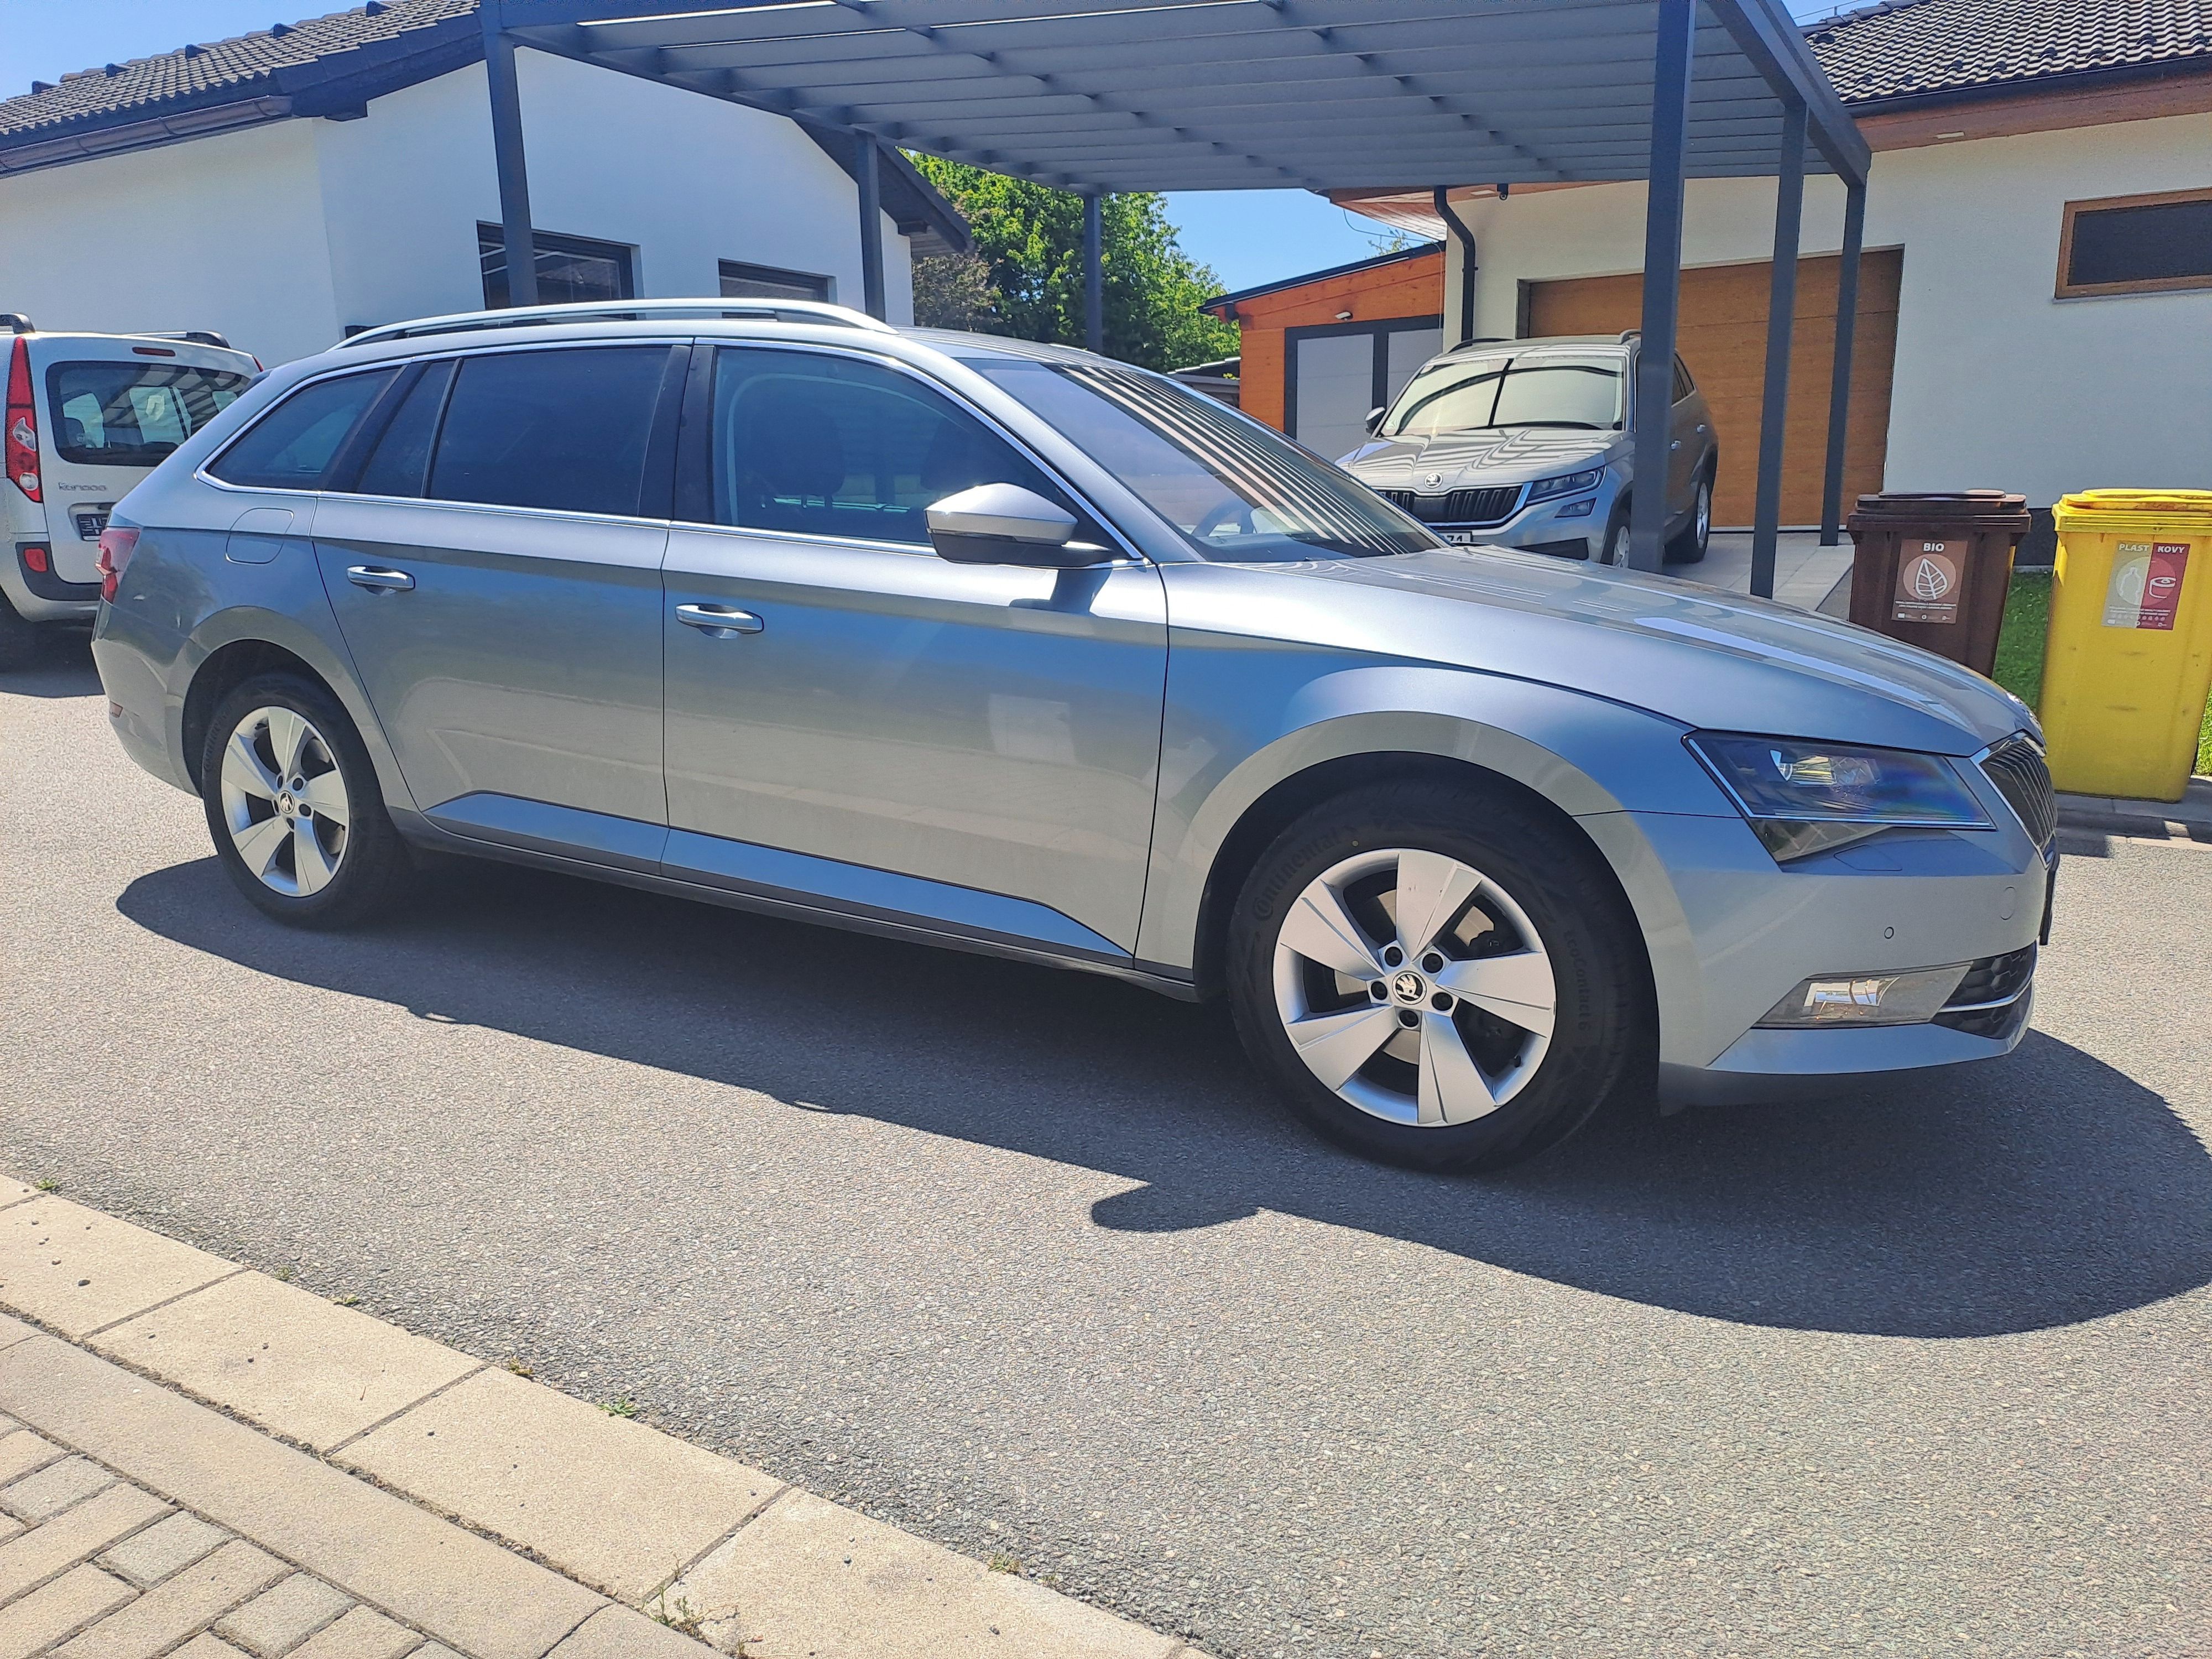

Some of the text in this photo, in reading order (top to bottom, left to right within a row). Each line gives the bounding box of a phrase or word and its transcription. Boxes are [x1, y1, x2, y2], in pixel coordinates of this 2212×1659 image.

[1923, 542, 1944, 552] BIO
[2119, 544, 2150, 552] PLAST
[1253, 826, 1341, 921] Continental
